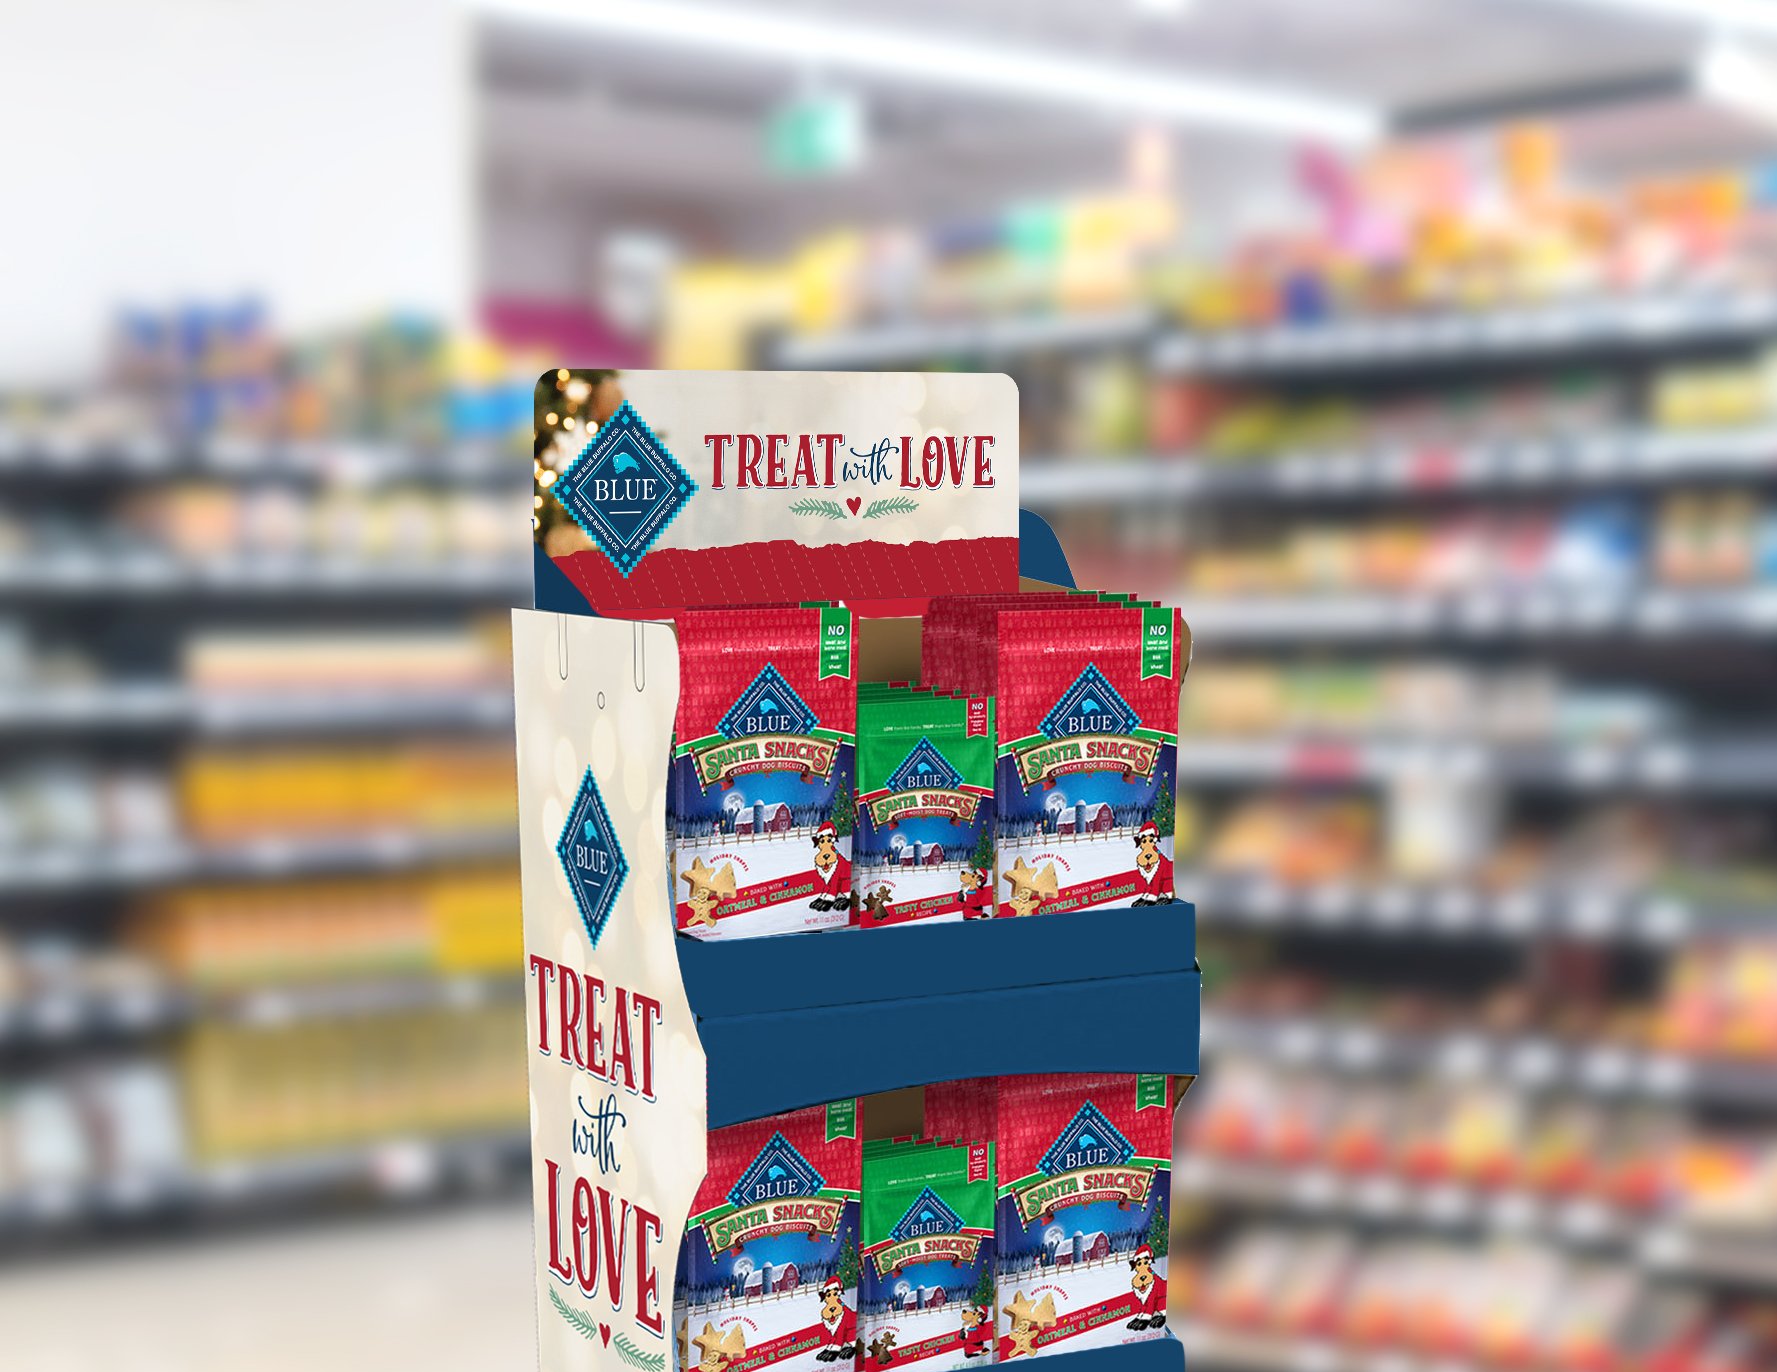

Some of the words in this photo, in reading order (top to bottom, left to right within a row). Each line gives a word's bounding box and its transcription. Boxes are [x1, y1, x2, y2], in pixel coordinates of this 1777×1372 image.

[581, 458, 594, 473] BLUE
[593, 436, 613, 460] BUFFALO
[640, 437, 652, 451] BLUE
[650, 450, 671, 473] BUFFALO
[704, 434, 846, 491] TREAT
[841, 437, 900, 486] with
[898, 435, 996, 490] LOVE
[594, 479, 658, 501] BLUE
[581, 507, 594, 522] BLUE
[593, 520, 613, 544] BUFFALO
[640, 526, 653, 542] BLUE
[650, 504, 671, 528] BUFFALO
[828, 625, 845, 636] NO
[1150, 625, 1167, 636] NO
[971, 702, 984, 710] NO
[746, 714, 791, 732] BLUE
[1068, 715, 1113, 733] BLUE
[705, 743, 760, 779] SANTA
[764, 741, 830, 771] SNACKS
[729, 763, 760, 777] CRUNCHY
[762, 761, 776, 769] DOG
[777, 761, 807, 772] BISCUITS
[1027, 743, 1082, 779] SANTA
[1086, 741, 1152, 771] SNACKS
[1051, 763, 1081, 777] CRUNCHY
[1099, 761, 1128, 772] BISCUITS
[907, 774, 942, 787] BLUE
[876, 795, 918, 821] SANTA
[921, 793, 974, 818] SNACKS
[576, 844, 608, 875] BLUE
[716, 899, 757, 915] OATMEAL
[760, 896, 767, 905] &
[769, 883, 814, 902] CINNAMON
[750, 886, 767, 896] BAKED
[769, 882, 782, 892] WITH
[1038, 899, 1079, 915] OATMEAL
[1082, 896, 1089, 905] &
[1091, 883, 1136, 902] CINNAMON
[1072, 886, 1090, 896] BAKED
[1090, 882, 1104, 892] WITH
[894, 902, 918, 914] TASTY
[920, 896, 953, 910] CHICKEN
[530, 953, 663, 1103] TREAT
[573, 1094, 626, 1175] with
[972, 1148, 984, 1157] NO
[1066, 1147, 1109, 1169] BLUE
[755, 1179, 798, 1200] BLUE
[1025, 1177, 1079, 1216] SANTA
[1083, 1173, 1146, 1198] SNACKS
[1049, 1196, 1079, 1212] CRUNCHY
[1081, 1193, 1094, 1201] DOG
[1096, 1192, 1124, 1201] BISCUITS
[715, 1208, 769, 1247] SANTA
[773, 1203, 836, 1232] SNACKS
[738, 1228, 768, 1243] CRUNCHY
[770, 1224, 783, 1233] DOG
[785, 1223, 813, 1232] BISCUITS
[910, 1220, 944, 1237] BLUE
[545, 1158, 665, 1340] LOVE
[880, 1242, 921, 1271] SANTA
[924, 1238, 975, 1258] SNACKS
[927, 1254, 939, 1262] DOG
[1037, 1325, 1076, 1345] OATMEAL
[1078, 1321, 1086, 1331] &
[1088, 1304, 1131, 1327] CINNAMON
[1069, 1311, 1086, 1322] BAKED
[1087, 1307, 1101, 1318] WITH
[758, 1342, 776, 1354] BAKED
[776, 1338, 790, 1349] WITH
[768, 1352, 776, 1362] &
[778, 1335, 820, 1358] CINNAMON
[898, 1344, 922, 1358] TASTY
[923, 1334, 956, 1352] CHICKEN
